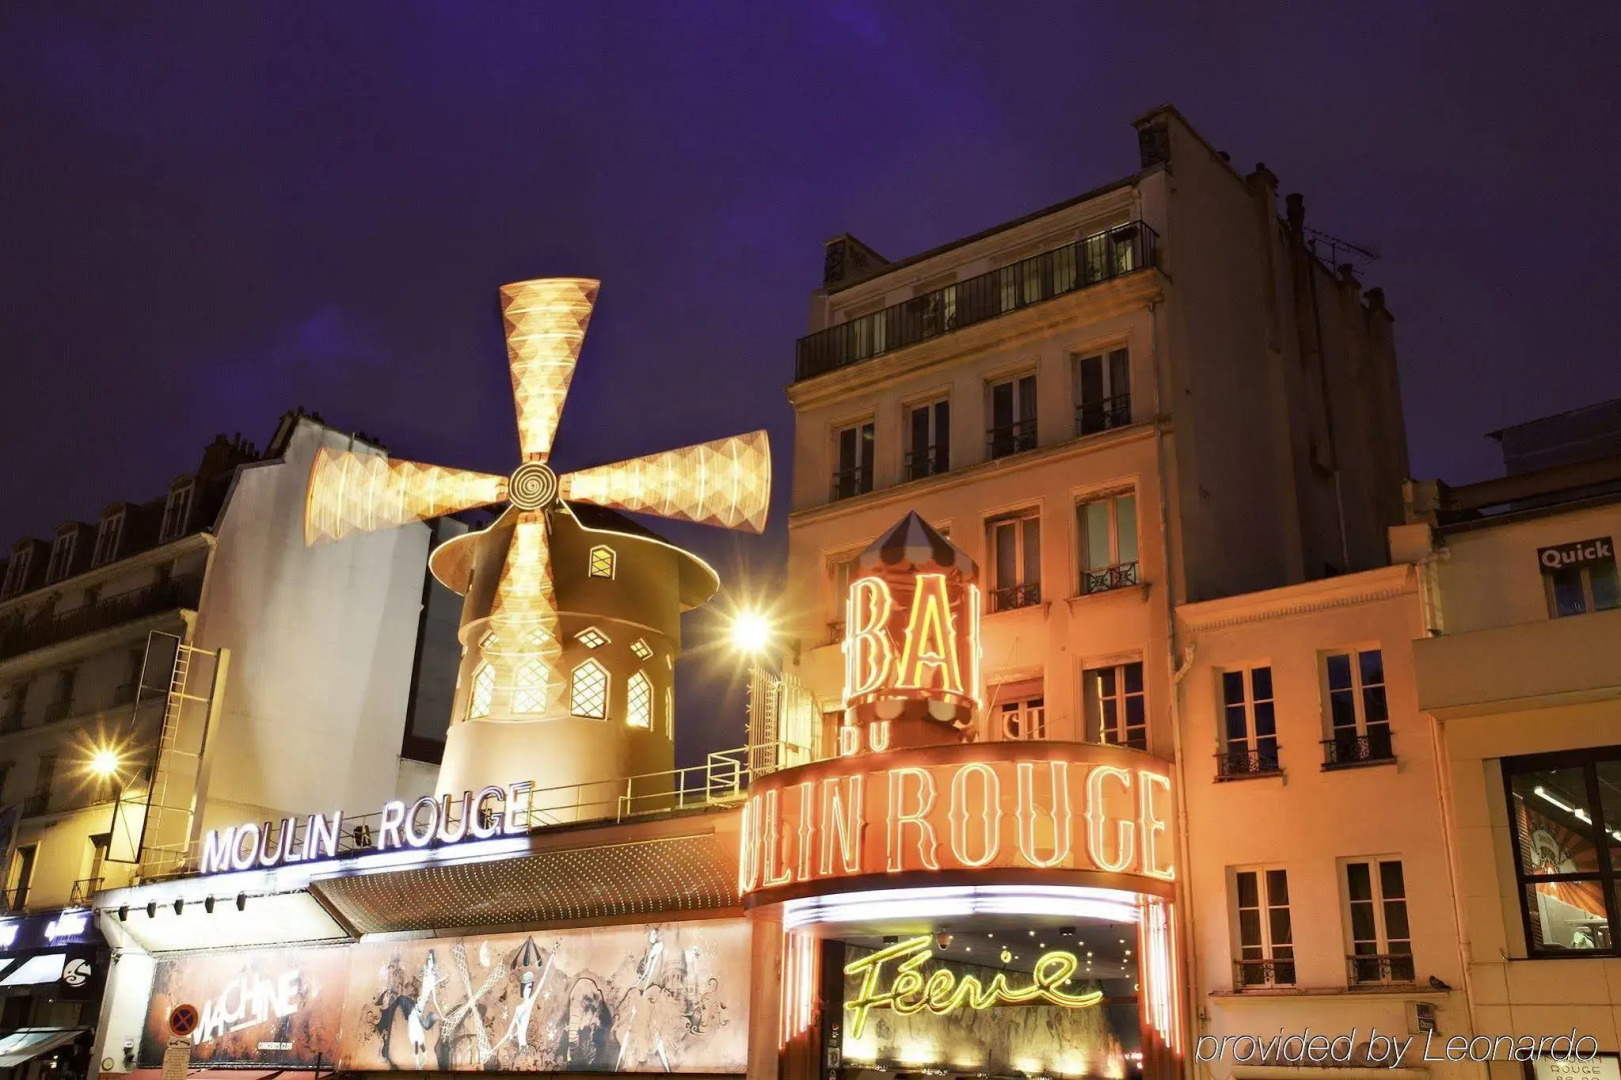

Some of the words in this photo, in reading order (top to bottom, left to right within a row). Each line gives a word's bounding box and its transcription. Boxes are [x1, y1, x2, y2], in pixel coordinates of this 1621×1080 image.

[1541, 540, 1612, 568] Quick
[840, 721, 890, 757] DU
[200, 809, 344, 874] MOULIN
[378, 780, 535, 849] ROUGE
[739, 773, 862, 898] ULIN
[887, 760, 1176, 881] ROUGE
[1551, 1064, 1601, 1074] ROUGE
